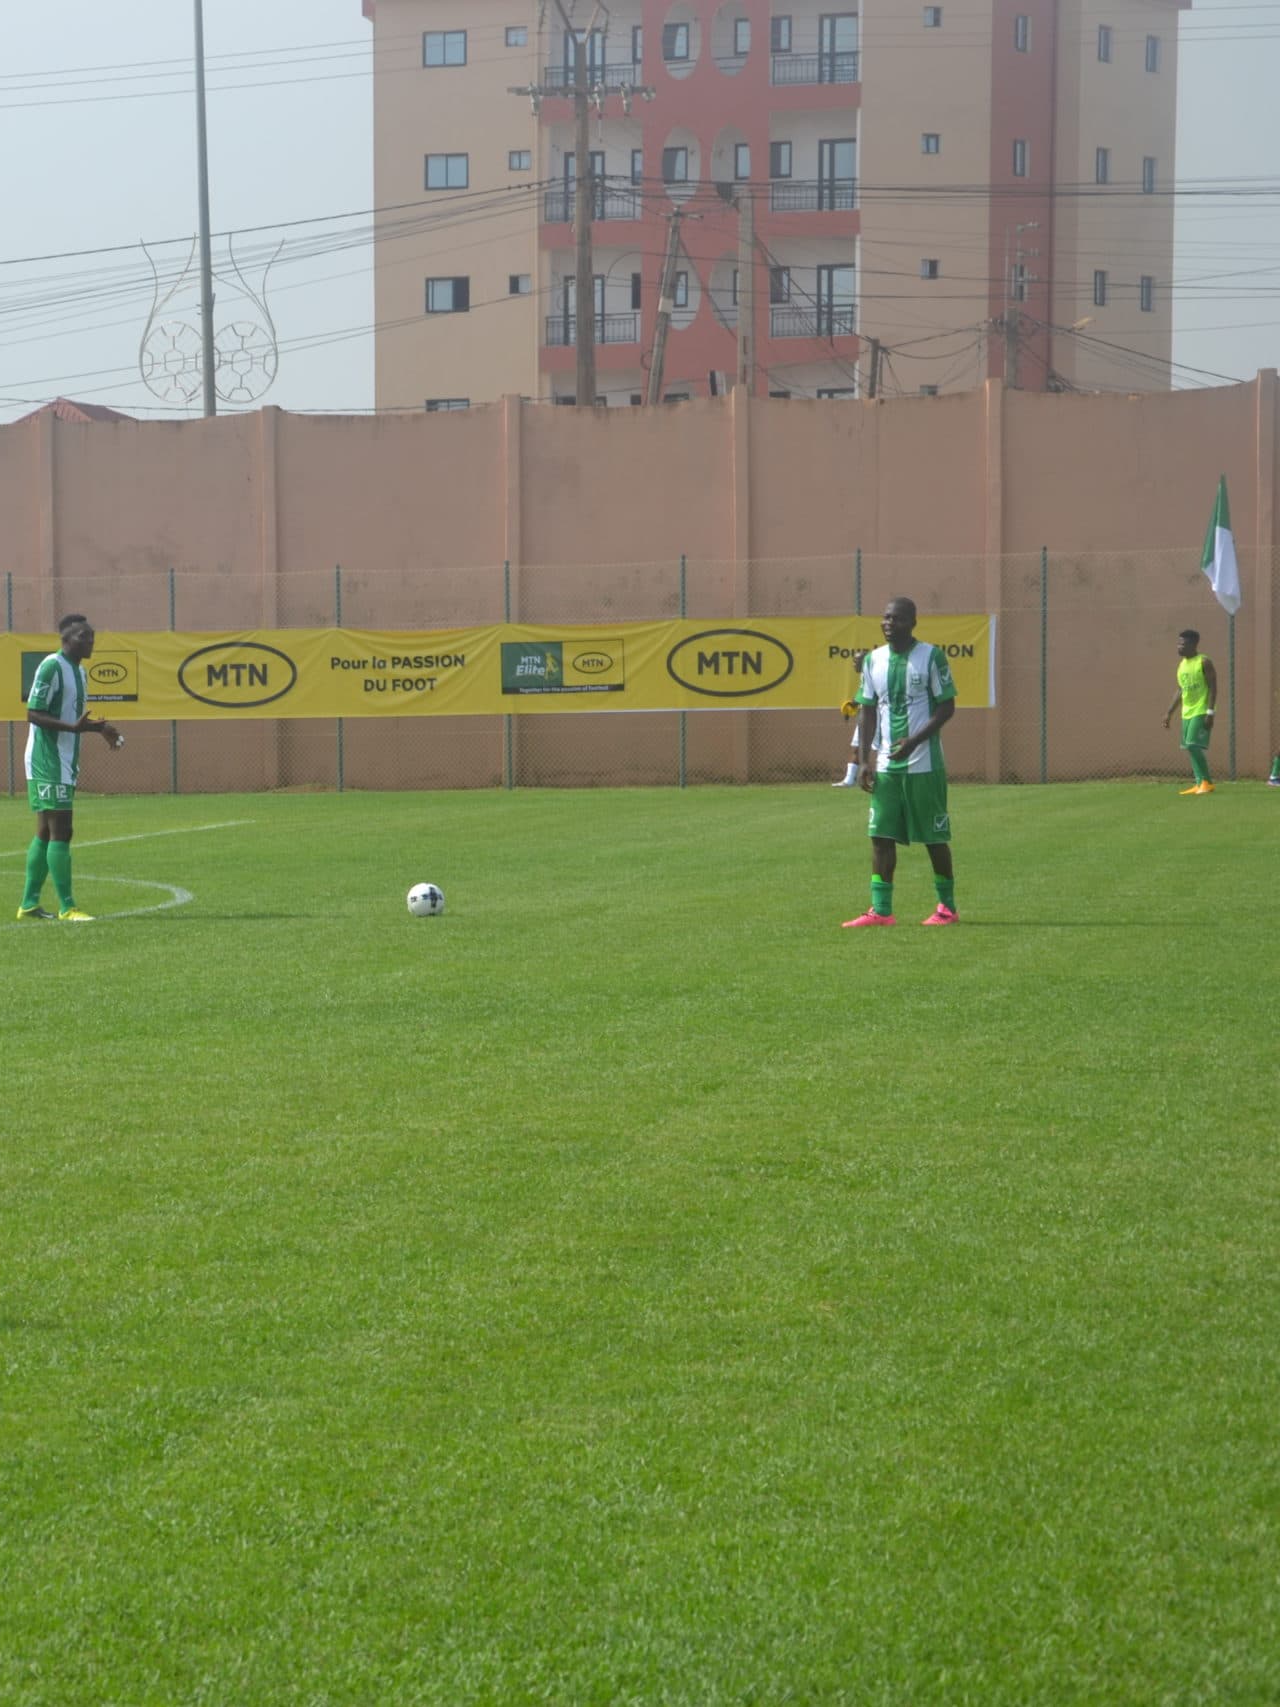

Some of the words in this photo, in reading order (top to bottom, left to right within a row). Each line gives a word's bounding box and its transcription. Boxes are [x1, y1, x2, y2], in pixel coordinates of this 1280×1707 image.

[331, 657, 368, 670] Pour
[372, 656, 387, 669] la
[391, 655, 465, 669] PASSION
[521, 656, 541, 664] MTN
[582, 658, 604, 668] MTN
[697, 651, 763, 675] MTN
[98, 668, 119, 677] MTN
[207, 664, 268, 688] MTN
[516, 664, 546, 676] Elite
[364, 679, 387, 692] DU
[391, 678, 438, 692] FOOT
